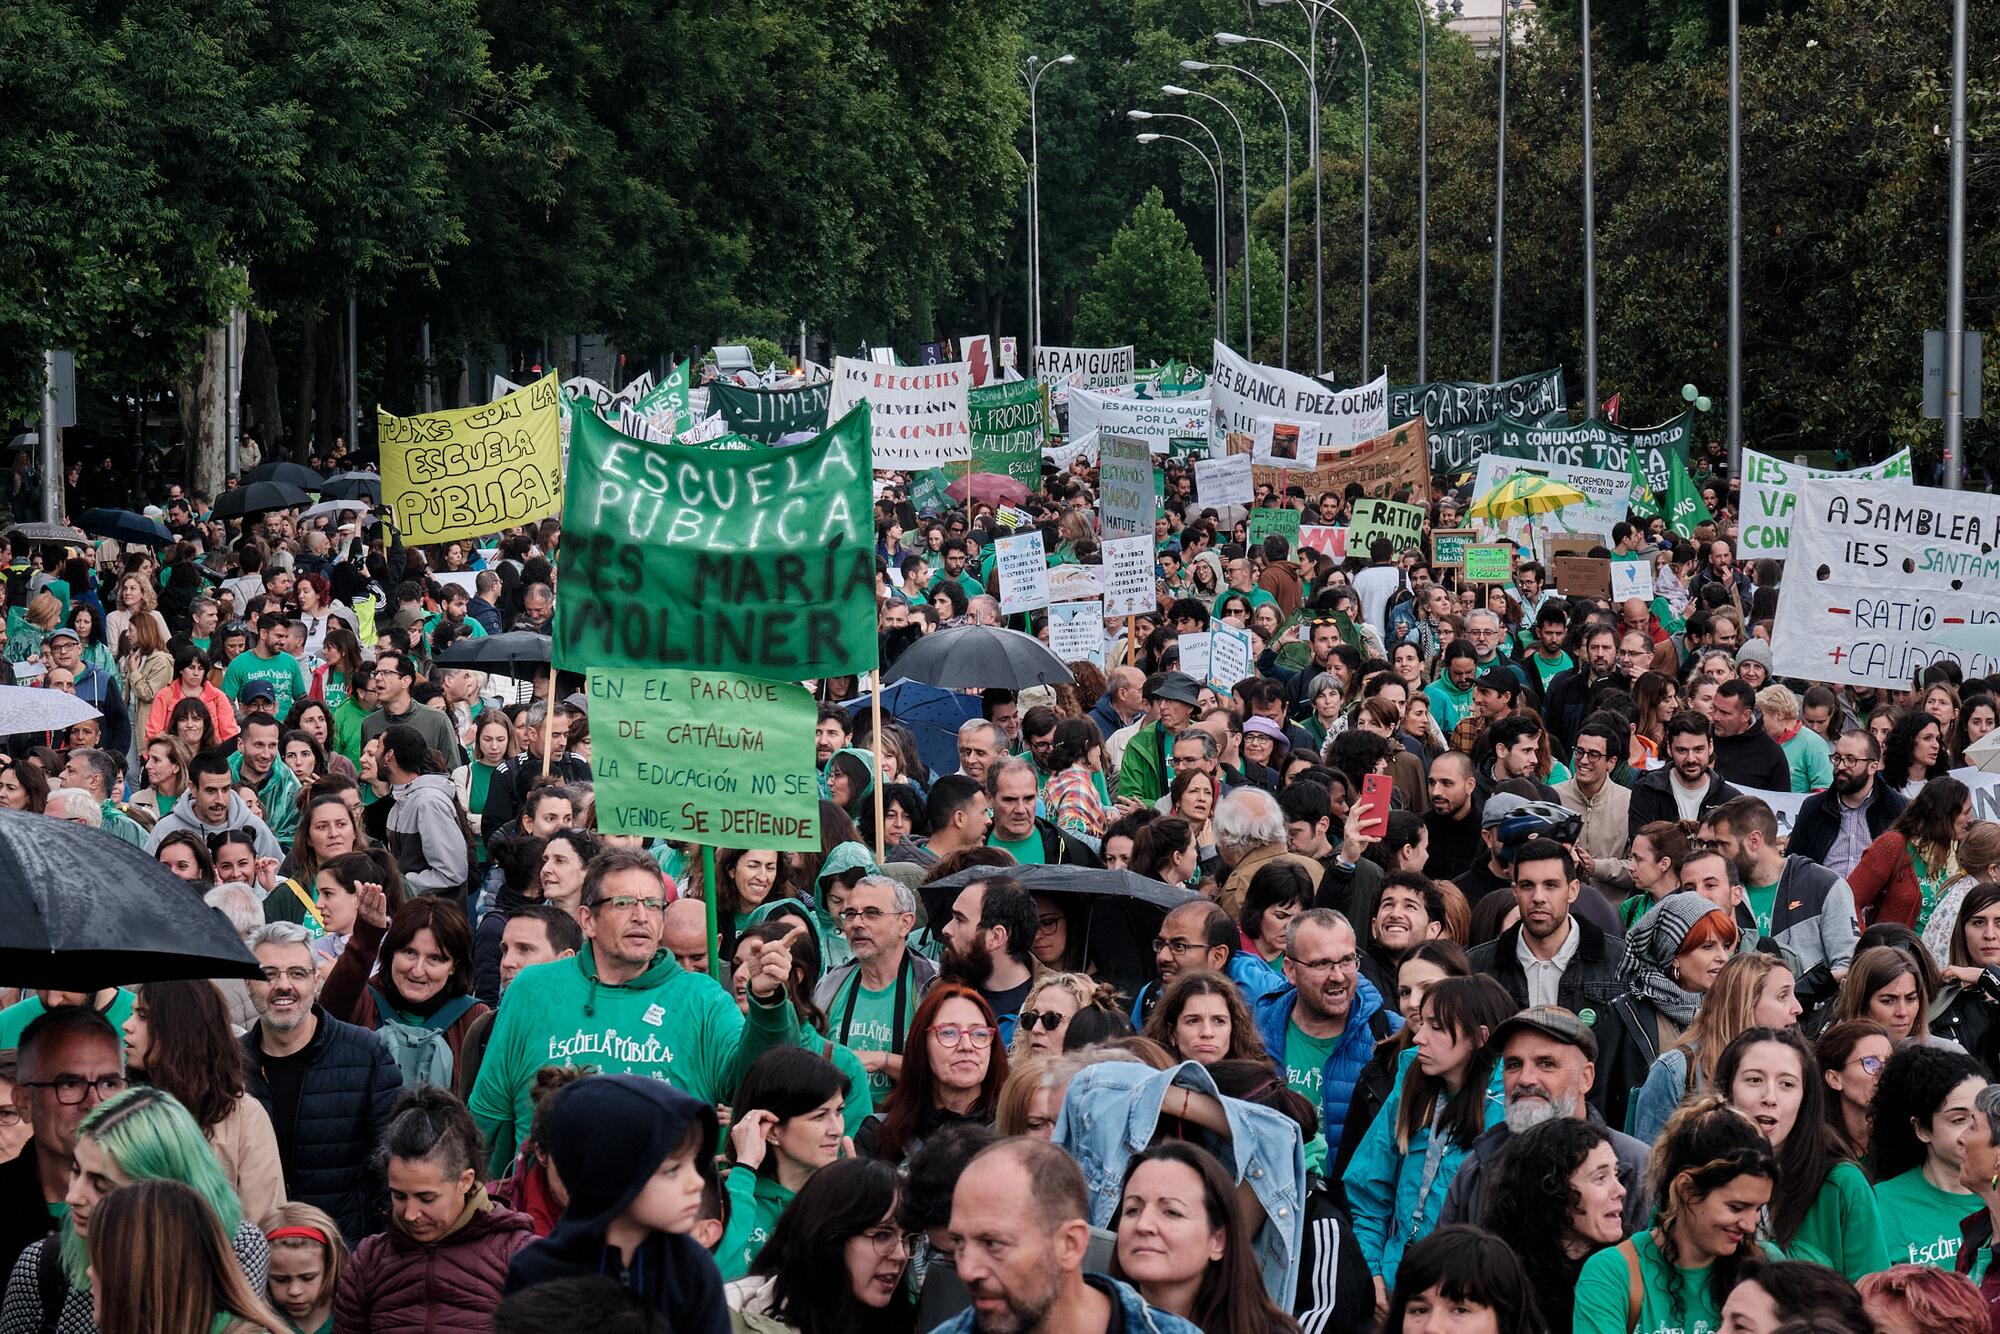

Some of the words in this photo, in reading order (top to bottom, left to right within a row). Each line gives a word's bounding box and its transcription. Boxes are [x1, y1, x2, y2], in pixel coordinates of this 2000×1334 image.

[1037, 350, 1132, 374] ARANGUREN
[846, 369, 868, 382] LOS
[874, 370, 959, 390] RECORTES
[1090, 374, 1128, 388] PÚBLICA
[1213, 360, 1233, 389] IES
[1233, 373, 1286, 408] BLANCA
[1342, 387, 1384, 415] OCHOA
[464, 398, 521, 429] CON
[531, 383, 556, 410] LA
[1122, 404, 1174, 414] ANTONIO
[1393, 395, 1420, 417] EL
[1423, 375, 1567, 427] CARRASCAL
[899, 421, 967, 439] CONTRA
[1136, 415, 1160, 424] POR
[1164, 416, 1178, 424] LA
[971, 430, 1033, 453] CALIDAD
[1503, 432, 1519, 446] LA
[1526, 430, 1605, 446] COMUNIDAD
[1609, 432, 1627, 446] DE
[1634, 427, 1683, 447] MADRID
[405, 429, 536, 484] ESCUELA
[1537, 446, 1582, 467] NOS
[1748, 456, 1788, 485] IES
[601, 435, 857, 510] ESCUELA
[1568, 475, 1614, 488] INCREMENTO
[397, 464, 551, 536] PÚBLICA
[593, 482, 856, 550] PÚBLICA
[1105, 514, 1136, 534] MATUTE
[1372, 502, 1422, 531] RATIO
[1827, 496, 1982, 546] ASAMBLEA
[1845, 540, 1888, 568] IES
[693, 532, 876, 606] MARÍA
[1855, 598, 1936, 632] RATIO
[569, 600, 850, 667] MOLINER
[592, 675, 624, 699] EN
[645, 679, 672, 701] EL
[690, 677, 778, 702] PARQUE
[618, 720, 646, 740] DE
[667, 723, 764, 751] CATALUÑA
[598, 757, 619, 778] LA
[638, 762, 737, 793] EDUCACIÓN
[752, 775, 776, 795] NO
[784, 774, 811, 795] SE
[616, 806, 675, 833] VENDE,
[681, 802, 709, 833] SE
[721, 809, 813, 839] DEFIENDE
[549, 1032, 612, 1059] ESCUELA
